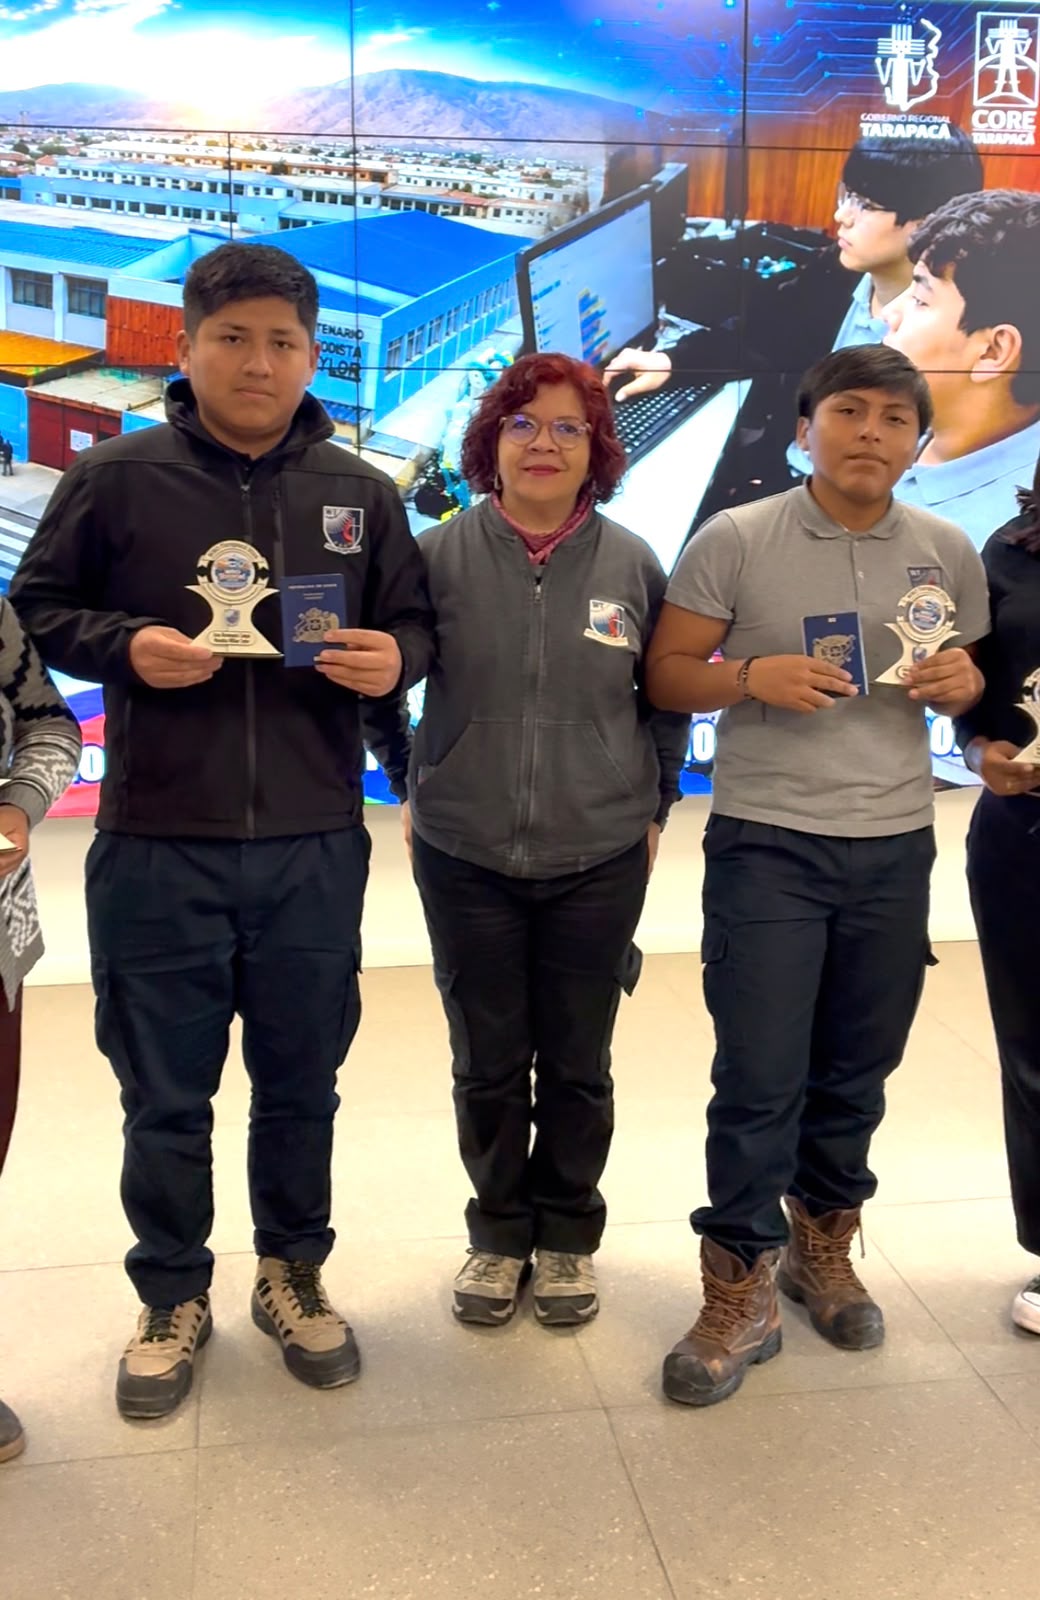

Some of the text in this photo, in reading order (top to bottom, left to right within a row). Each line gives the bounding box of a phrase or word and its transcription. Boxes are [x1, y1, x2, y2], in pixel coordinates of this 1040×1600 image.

[860, 112, 951, 123] GOBIERNO REGIONAL
[971, 109, 1037, 129] CORE
